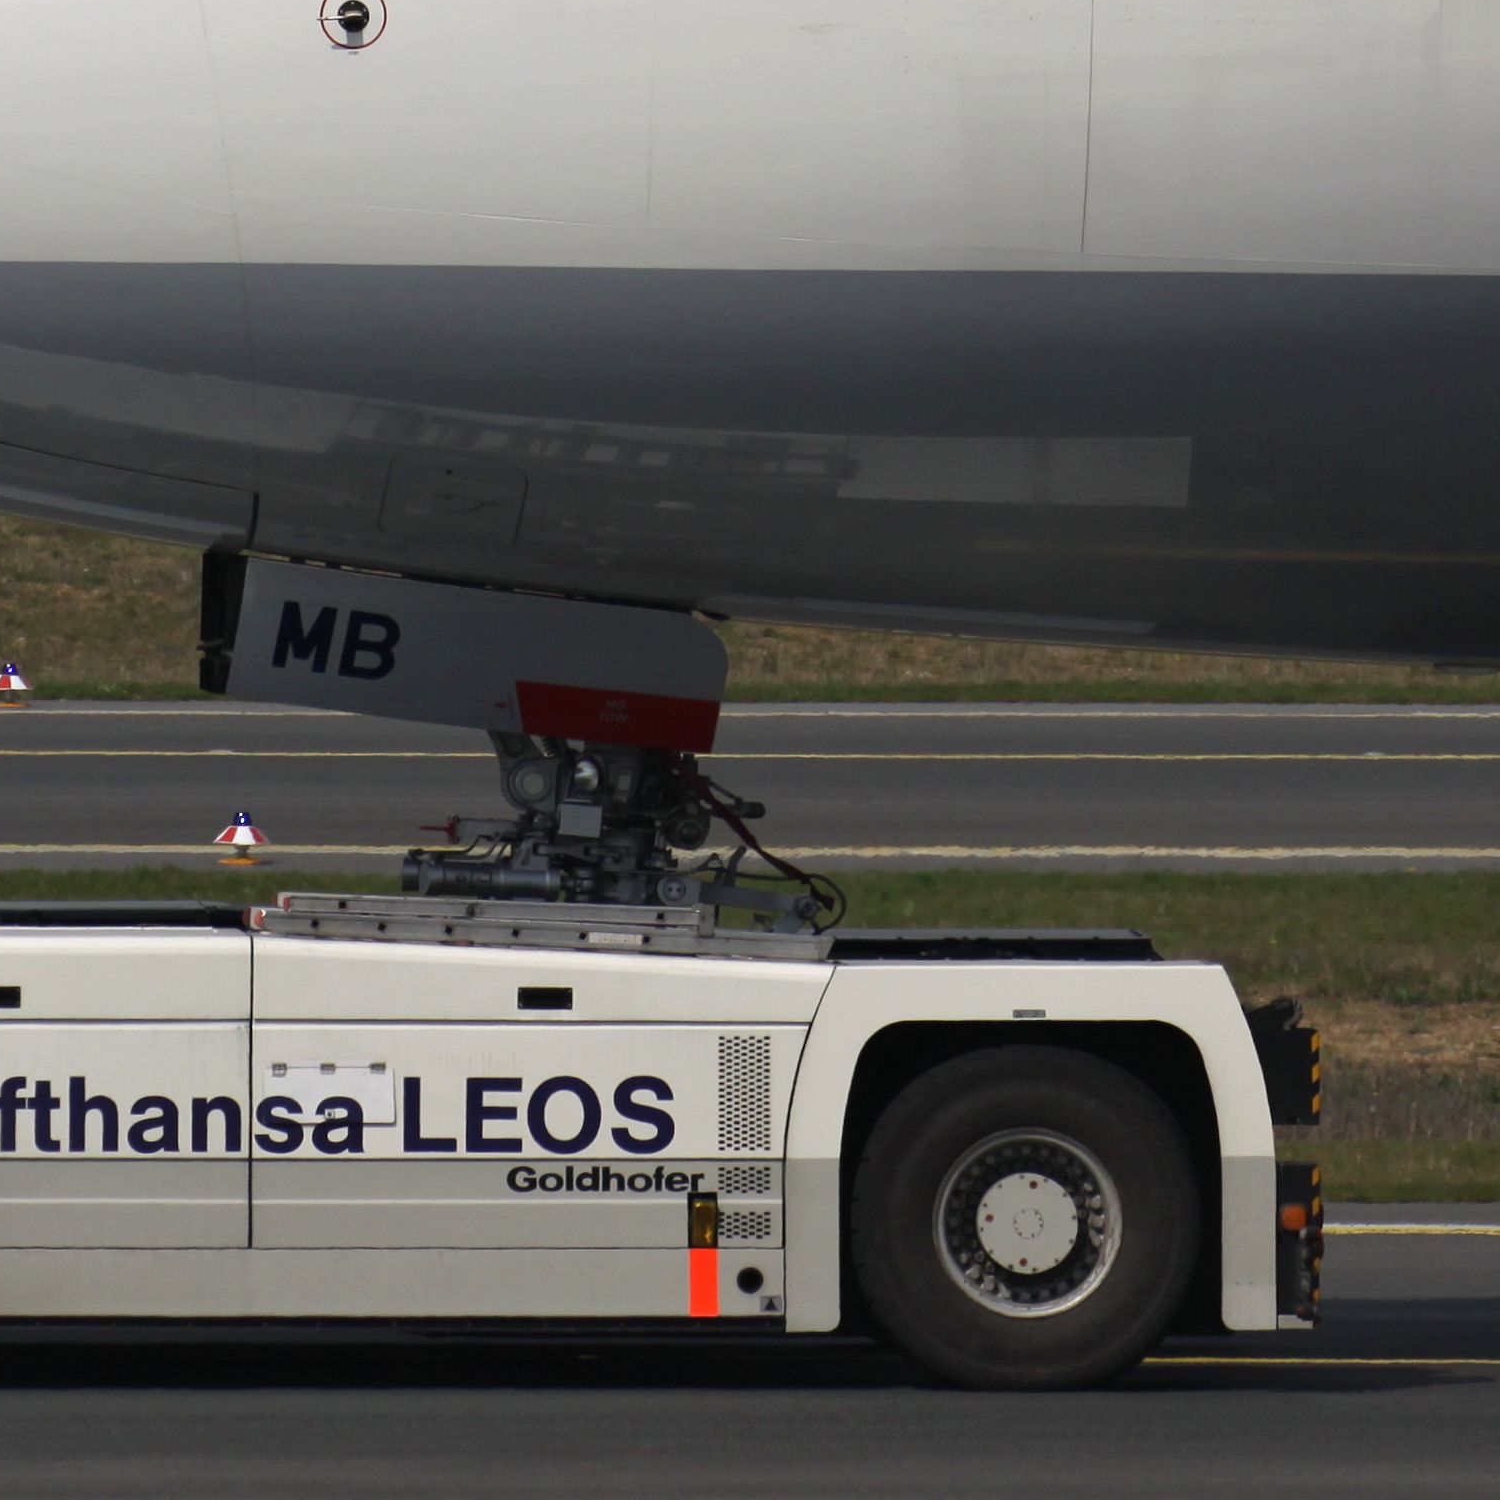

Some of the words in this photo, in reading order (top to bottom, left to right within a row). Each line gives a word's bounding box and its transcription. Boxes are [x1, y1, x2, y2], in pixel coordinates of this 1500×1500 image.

[272, 601, 401, 680] MB
[599, 711, 628, 724] TOW
[604, 699, 626, 710] NO
[403, 1075, 676, 1155] LEOS
[506, 1165, 705, 1193] Goldhofer
